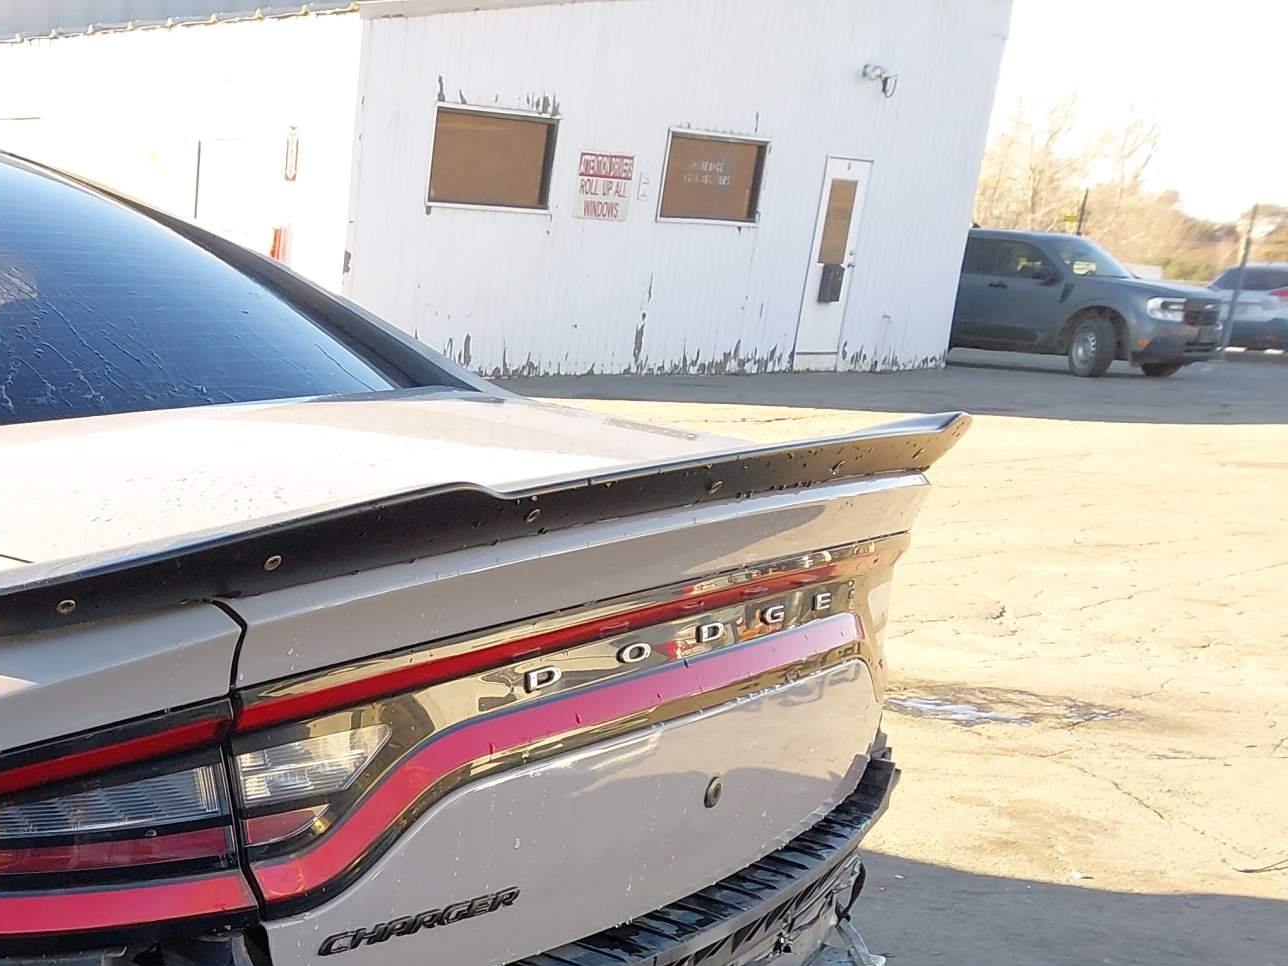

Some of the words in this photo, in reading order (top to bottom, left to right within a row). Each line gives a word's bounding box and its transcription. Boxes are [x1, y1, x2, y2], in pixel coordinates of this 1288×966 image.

[580, 178, 599, 196] ROLL
[602, 180, 614, 197] UP
[614, 181, 627, 198] ALL
[583, 199, 620, 218] WINDOWS
[524, 592, 832, 691] DODGE
[317, 886, 520, 956] CHARGER
